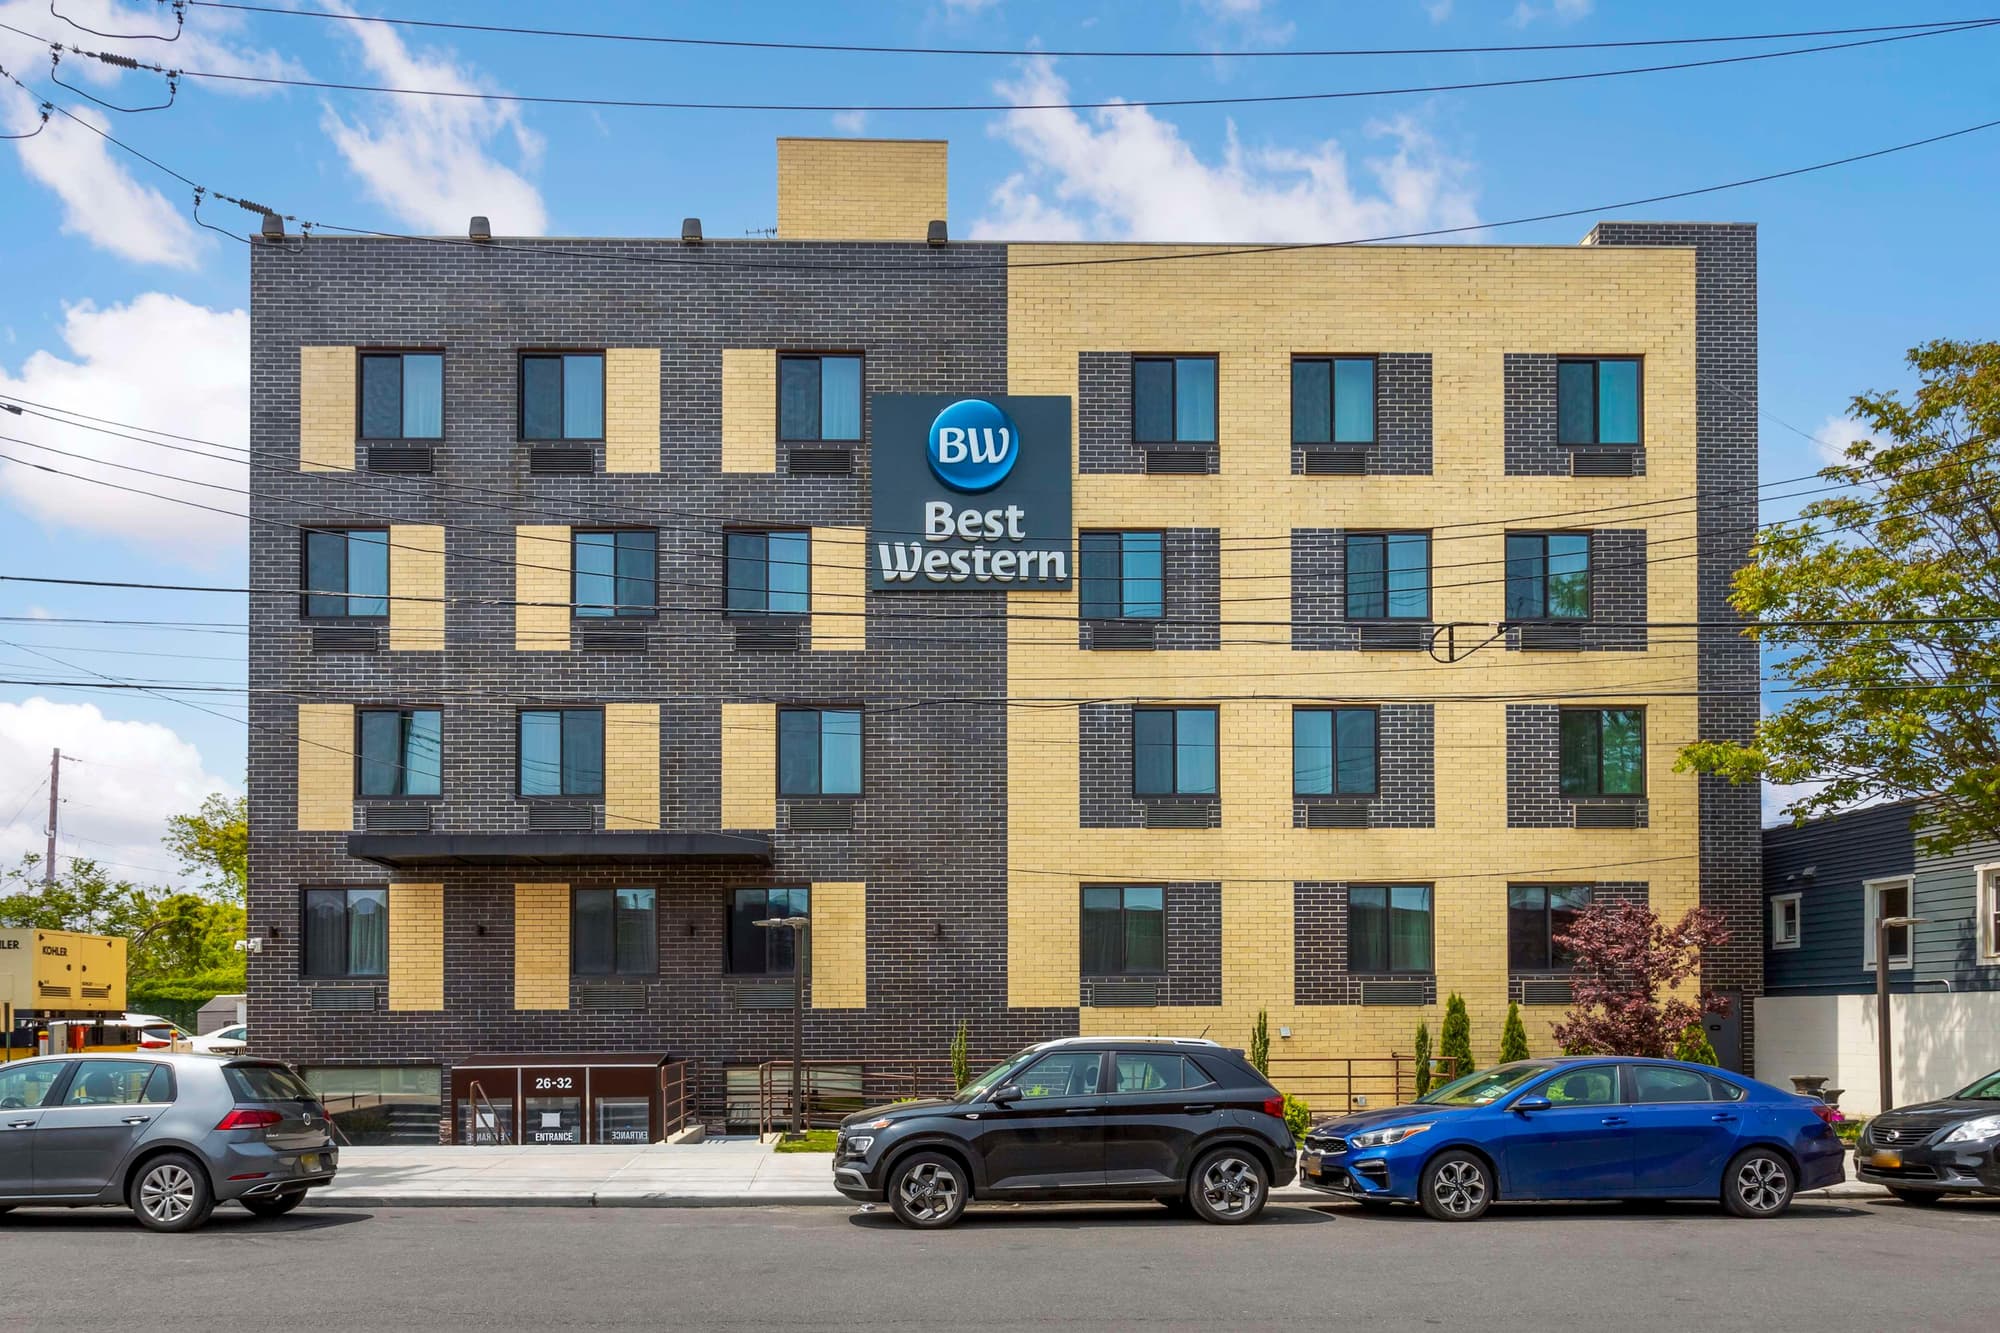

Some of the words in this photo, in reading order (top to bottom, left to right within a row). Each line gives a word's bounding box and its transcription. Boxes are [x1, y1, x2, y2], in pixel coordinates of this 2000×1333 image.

[939, 427, 1010, 464] BW
[925, 501, 1026, 542] Best
[878, 541, 1068, 582] Western
[0, 939, 20, 950] LER
[42, 946, 68, 956] KOHLER
[535, 1077, 573, 1089] 26-32
[535, 1132, 574, 1142] ENTRANCE
